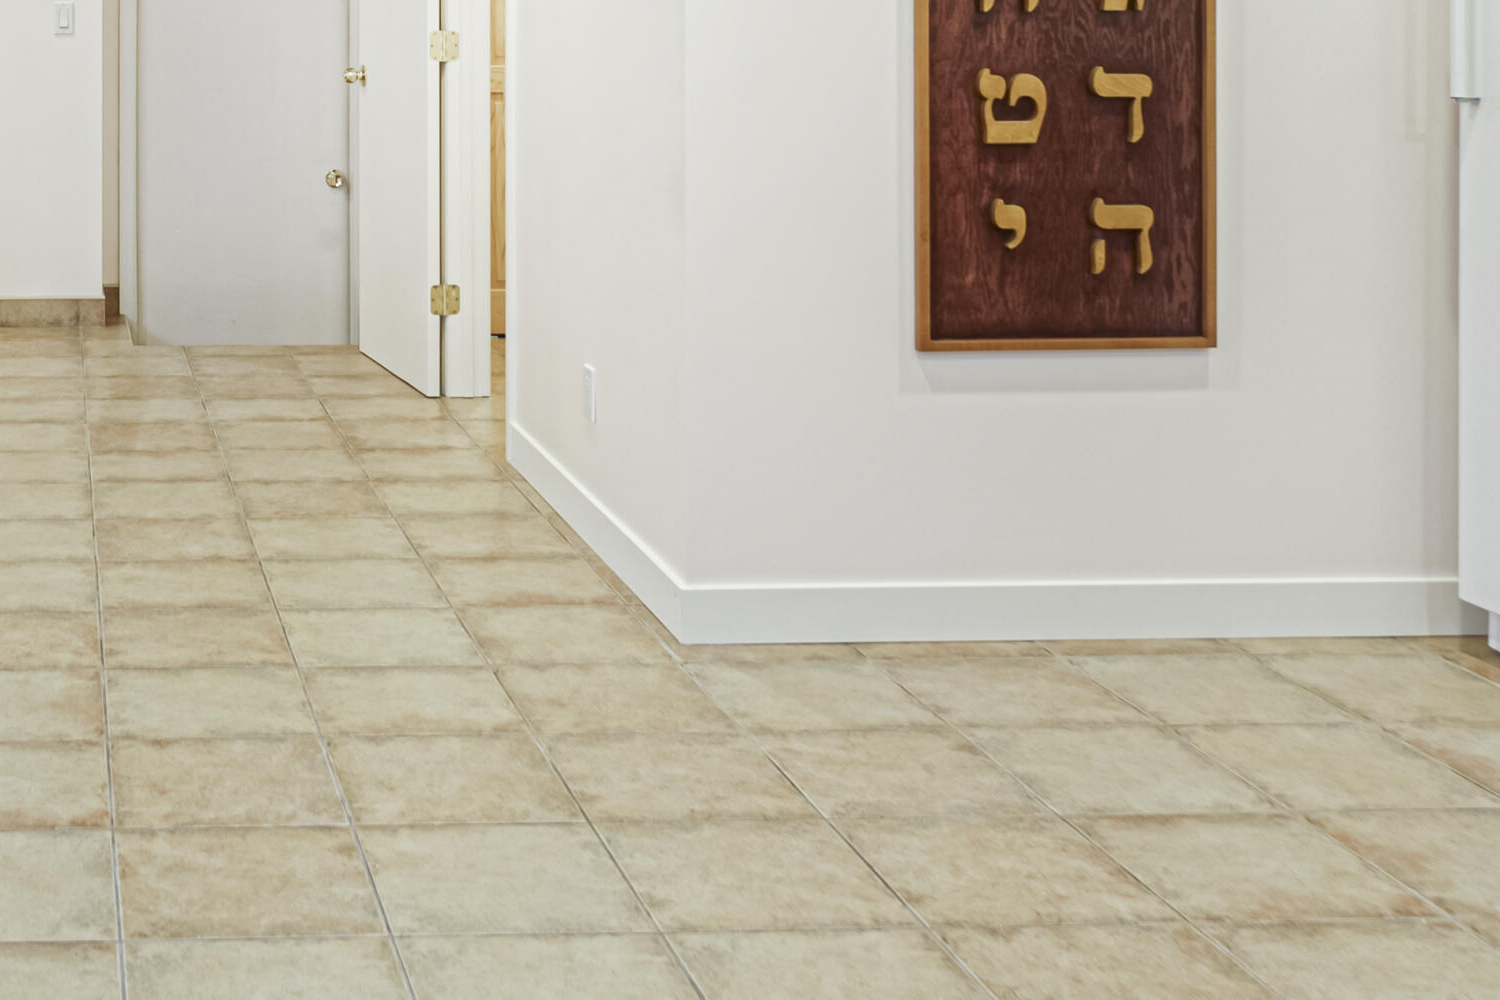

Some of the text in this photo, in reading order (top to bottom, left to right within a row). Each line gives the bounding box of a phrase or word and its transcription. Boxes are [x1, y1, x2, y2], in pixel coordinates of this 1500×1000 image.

[978, 68, 1047, 144] ט
[1092, 66, 1153, 143] ד
[994, 198, 1027, 249] י
[1092, 197, 1154, 274] ה
